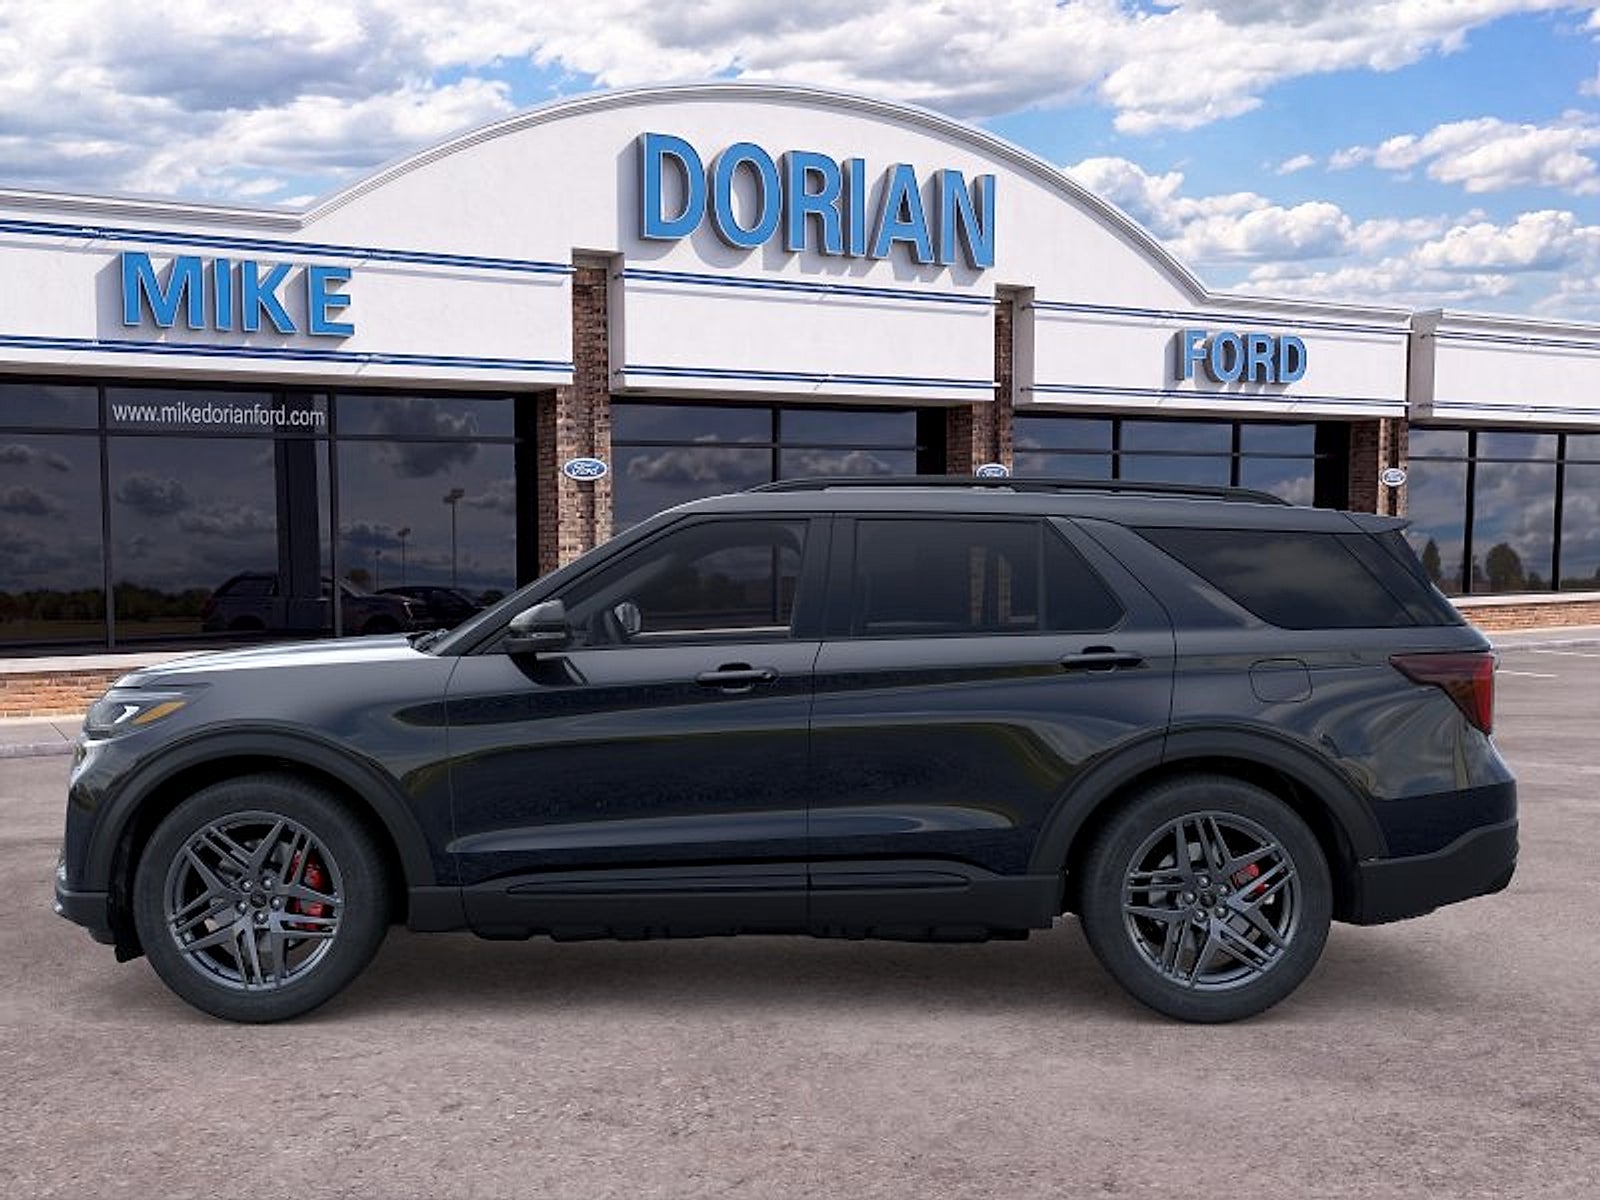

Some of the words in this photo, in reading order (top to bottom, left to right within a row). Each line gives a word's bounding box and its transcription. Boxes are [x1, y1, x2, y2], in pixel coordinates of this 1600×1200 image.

[641, 132, 995, 269] DORIAN
[121, 252, 355, 336] MIKE
[1178, 328, 1307, 384] FORD
[112, 402, 325, 426] www.mikedorianford.com
